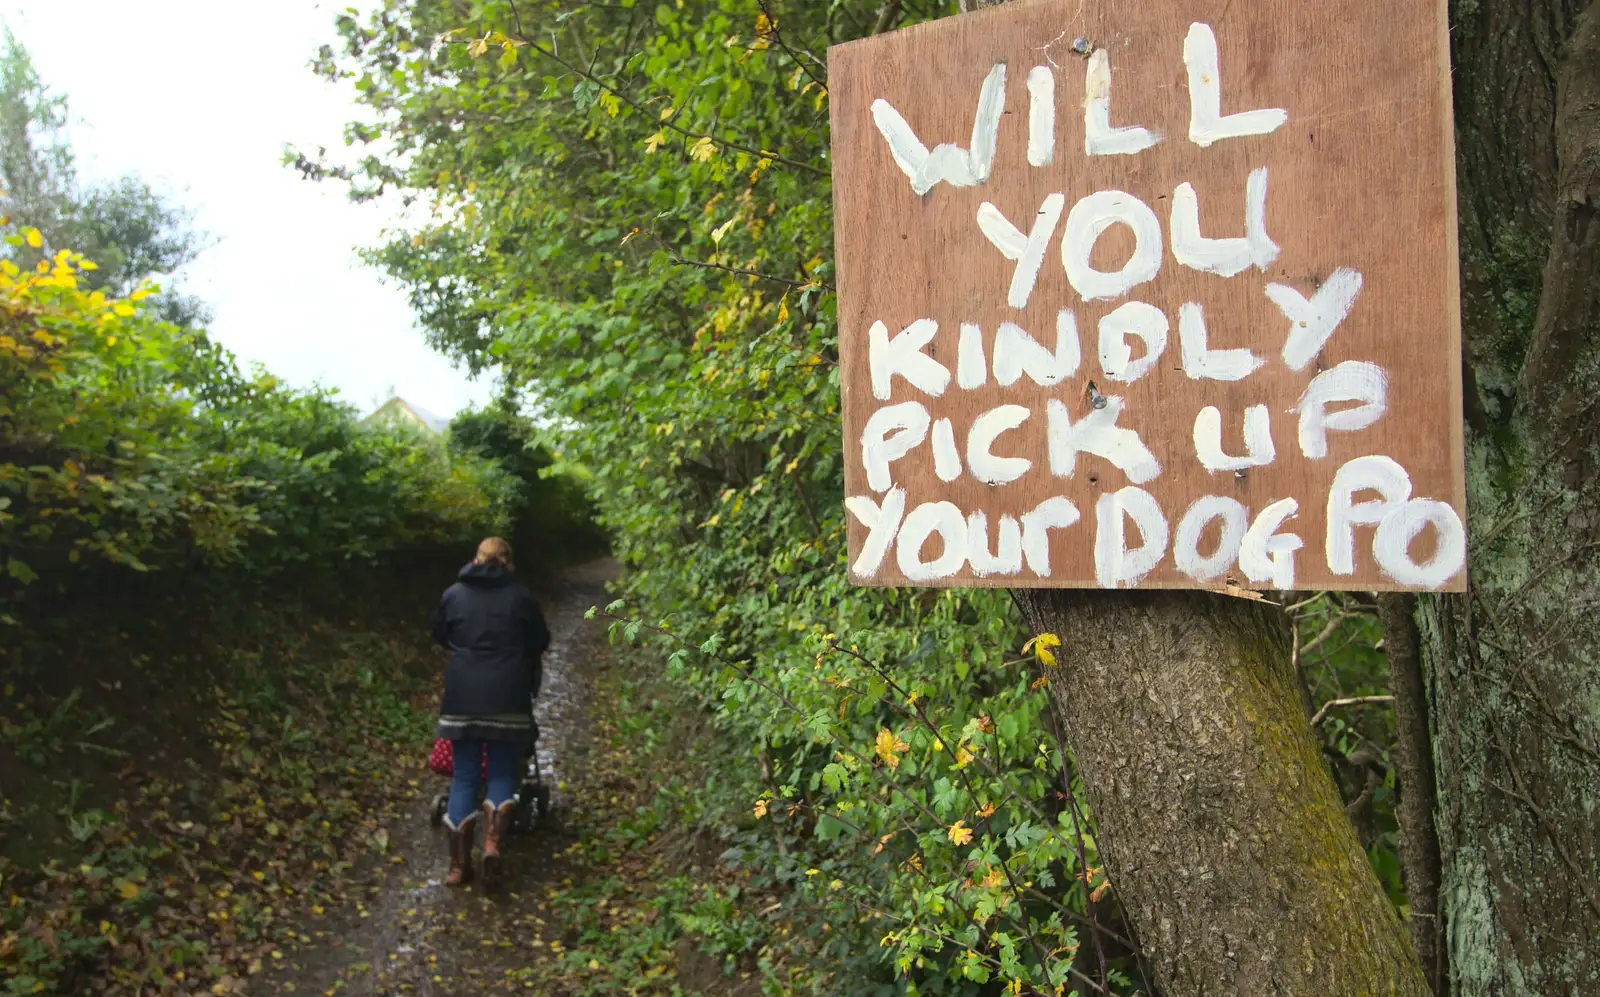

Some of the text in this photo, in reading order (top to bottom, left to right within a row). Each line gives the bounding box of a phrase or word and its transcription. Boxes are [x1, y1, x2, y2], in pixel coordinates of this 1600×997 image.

[870, 22, 1288, 196] WILL
[977, 166, 1281, 310] YOU
[868, 266, 1363, 401] KINDLY
[860, 360, 1389, 493] PICK UP
[1094, 486, 1304, 590] DOG
[1326, 455, 1467, 591] PO
